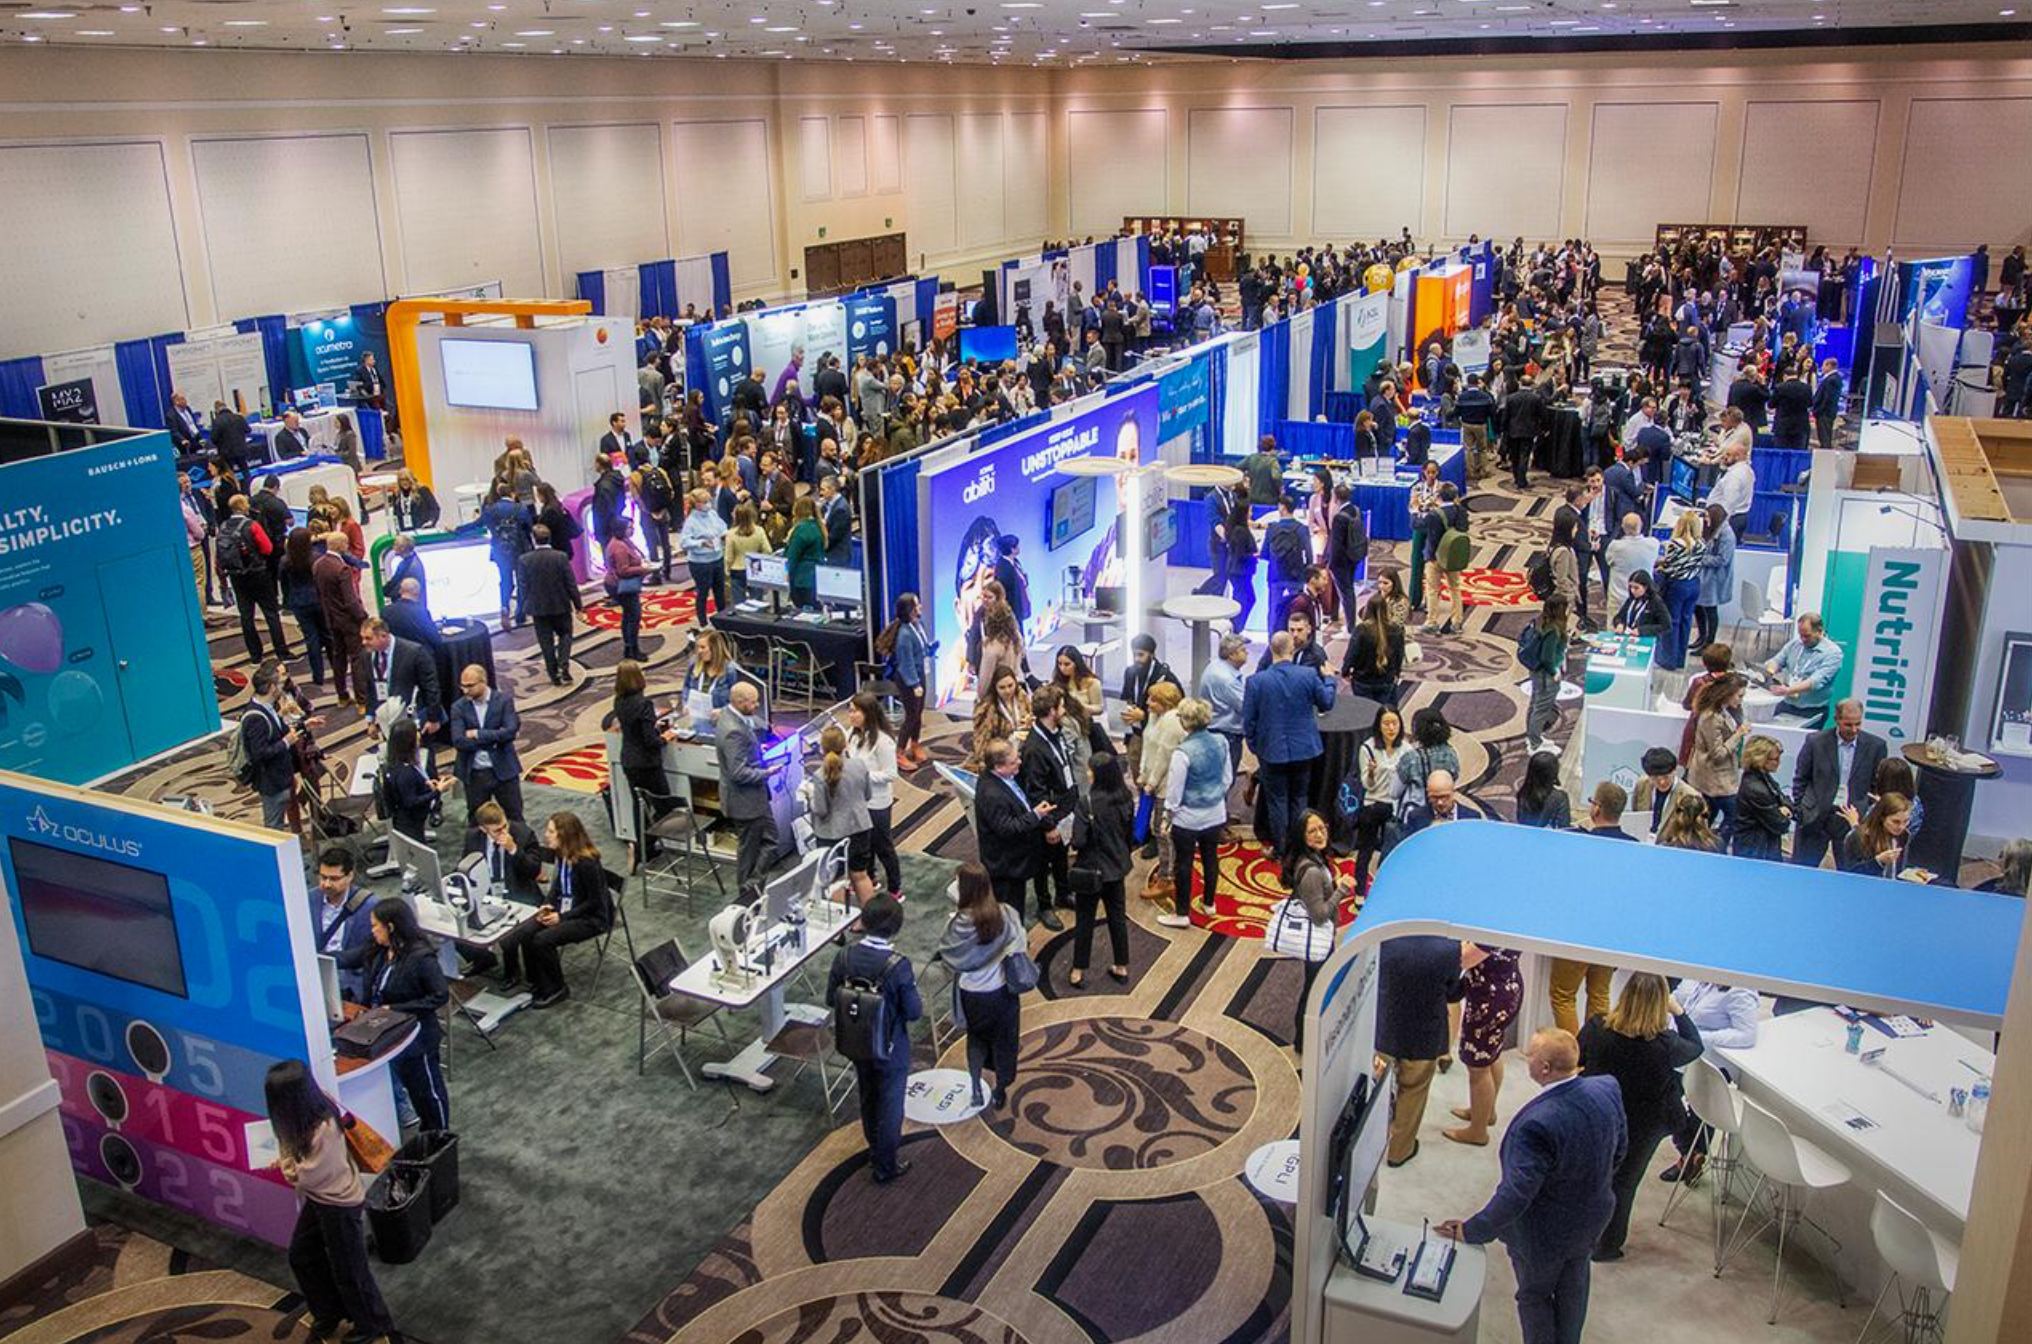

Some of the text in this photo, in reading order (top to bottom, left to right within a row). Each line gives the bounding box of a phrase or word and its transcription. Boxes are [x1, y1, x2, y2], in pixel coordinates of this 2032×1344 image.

[51, 387, 83, 408] MX2
[88, 462, 126, 477] BAUSCH
[134, 453, 158, 466] LOMB
[1021, 426, 1099, 476] UNSTOPPABLE
[0, 505, 49, 532] LTY,
[0, 509, 122, 554] SIMPLICITY.
[1864, 560, 1921, 724] Nutrifill
[63, 825, 140, 858] OCULUS
